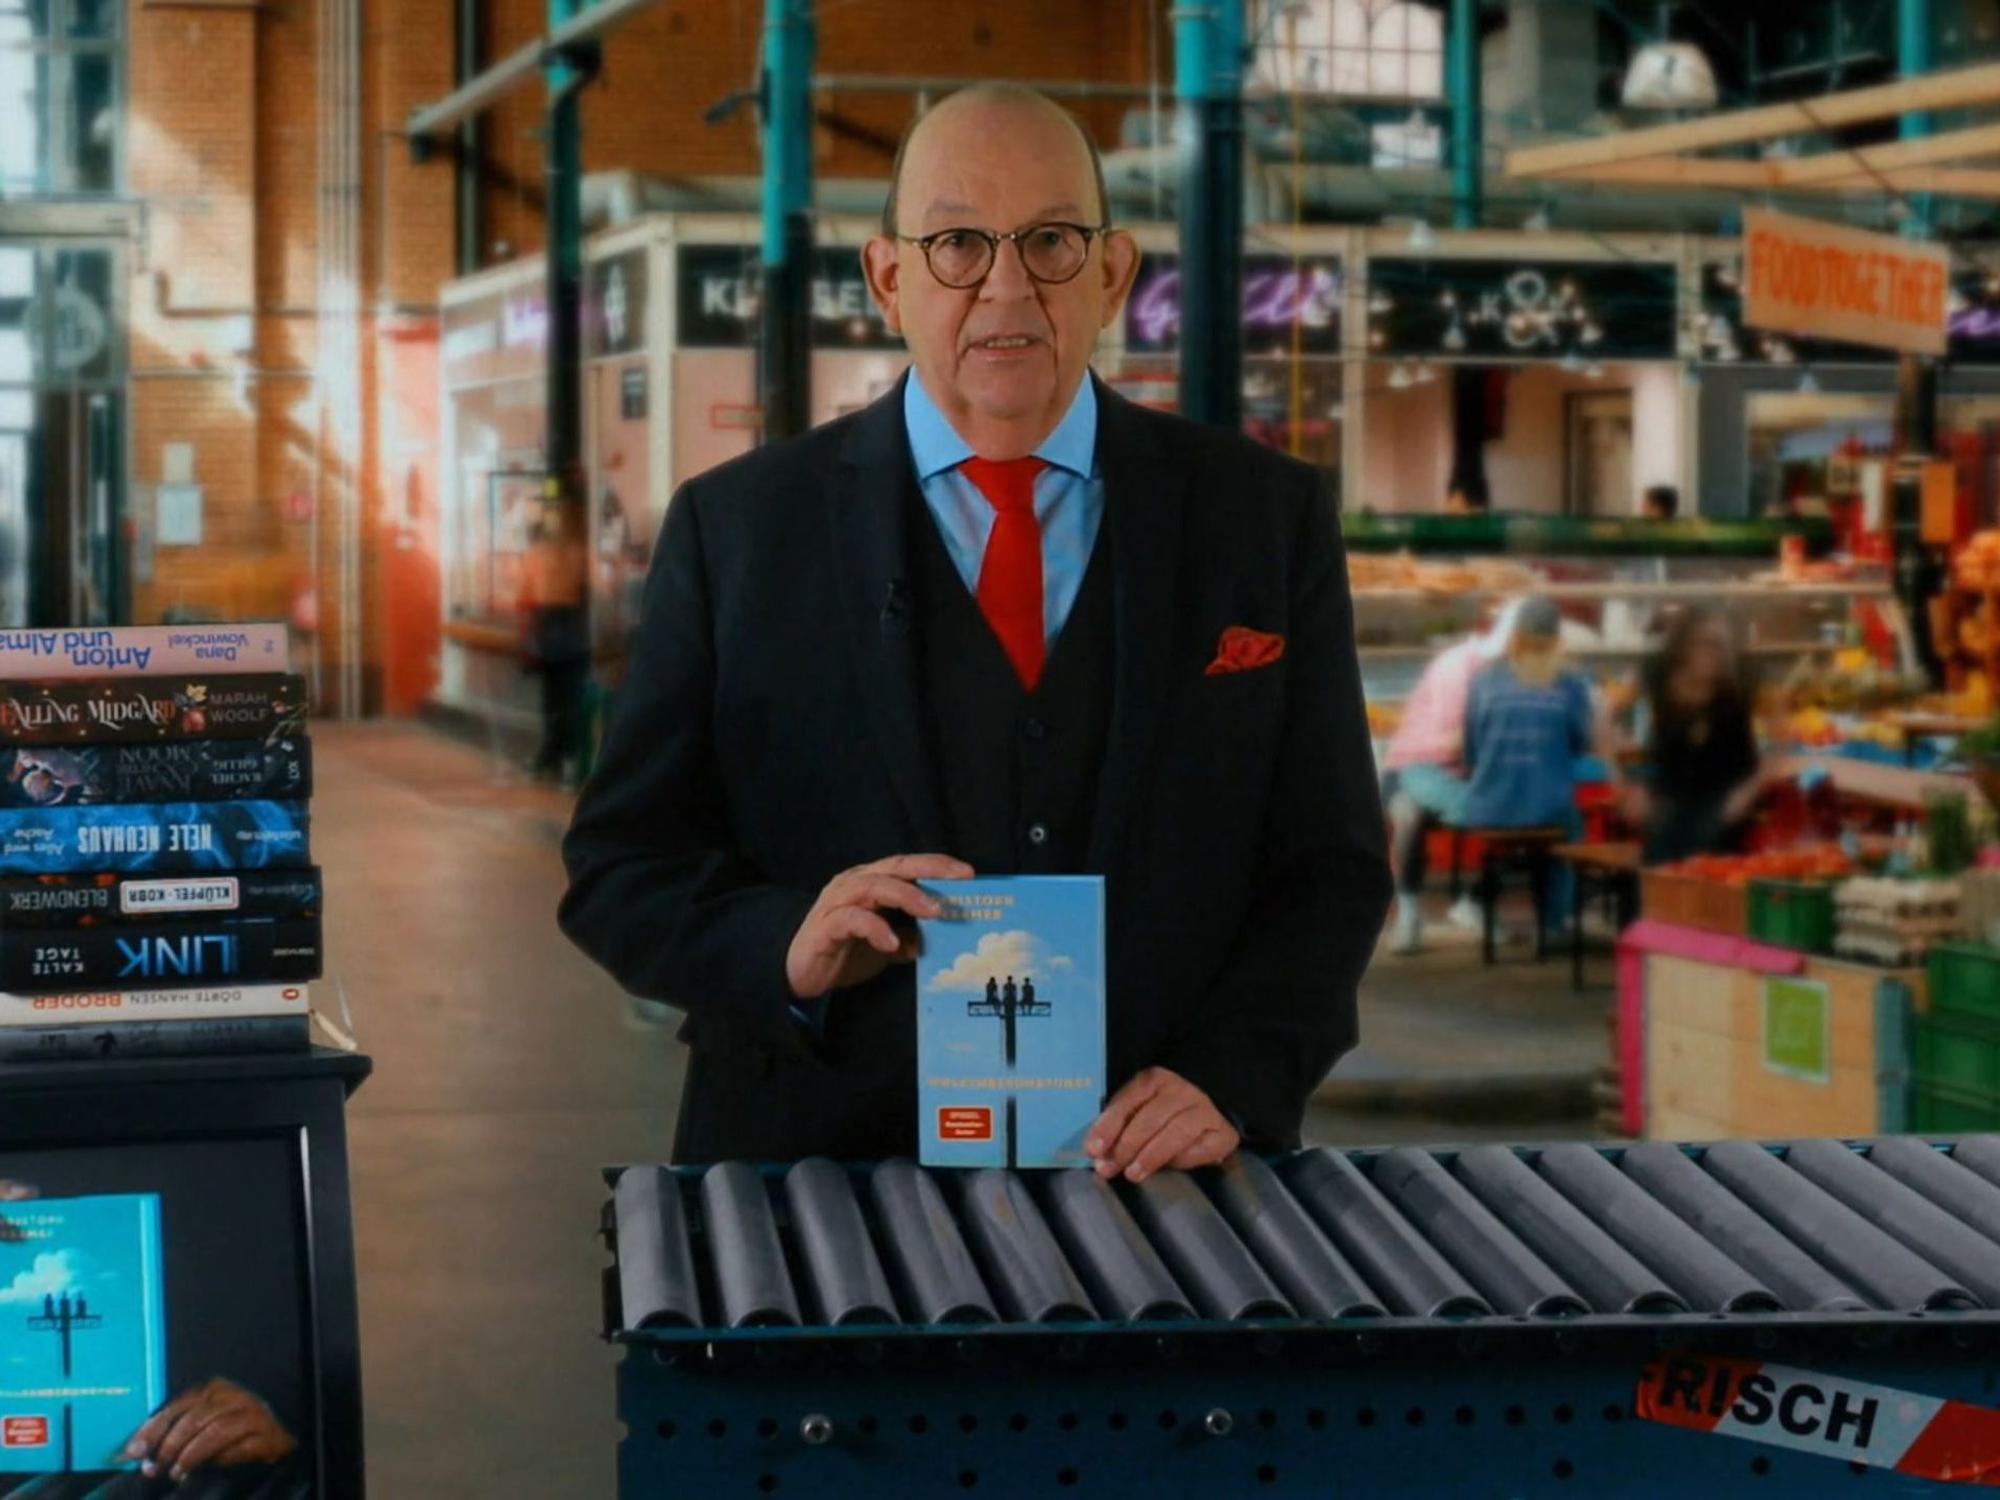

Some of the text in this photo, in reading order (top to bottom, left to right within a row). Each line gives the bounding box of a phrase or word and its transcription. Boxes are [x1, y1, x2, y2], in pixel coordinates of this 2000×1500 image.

[64, 631, 113, 655] und
[168, 633, 249, 648] Vowinckel
[72, 646, 151, 670] Anton
[195, 647, 237, 661] Dana
[210, 693, 268, 705] MARAH
[87, 693, 176, 730] MIDGARD
[210, 709, 268, 723] WOOLF
[78, 825, 160, 853] NEUHAUS
[169, 824, 213, 851] NELE
[9, 888, 108, 910] BLENDWERK
[128, 888, 165, 902] KOBR
[174, 886, 231, 902] KLÜPFEL
[35, 948, 81, 961] TAGE
[115, 935, 239, 977] LINK
[32, 963, 84, 975] KALTE
[32, 993, 122, 1009] BRODER
[130, 990, 242, 1005] DÖRTE HANSEN
[1643, 1356, 1879, 1449] RISCH
